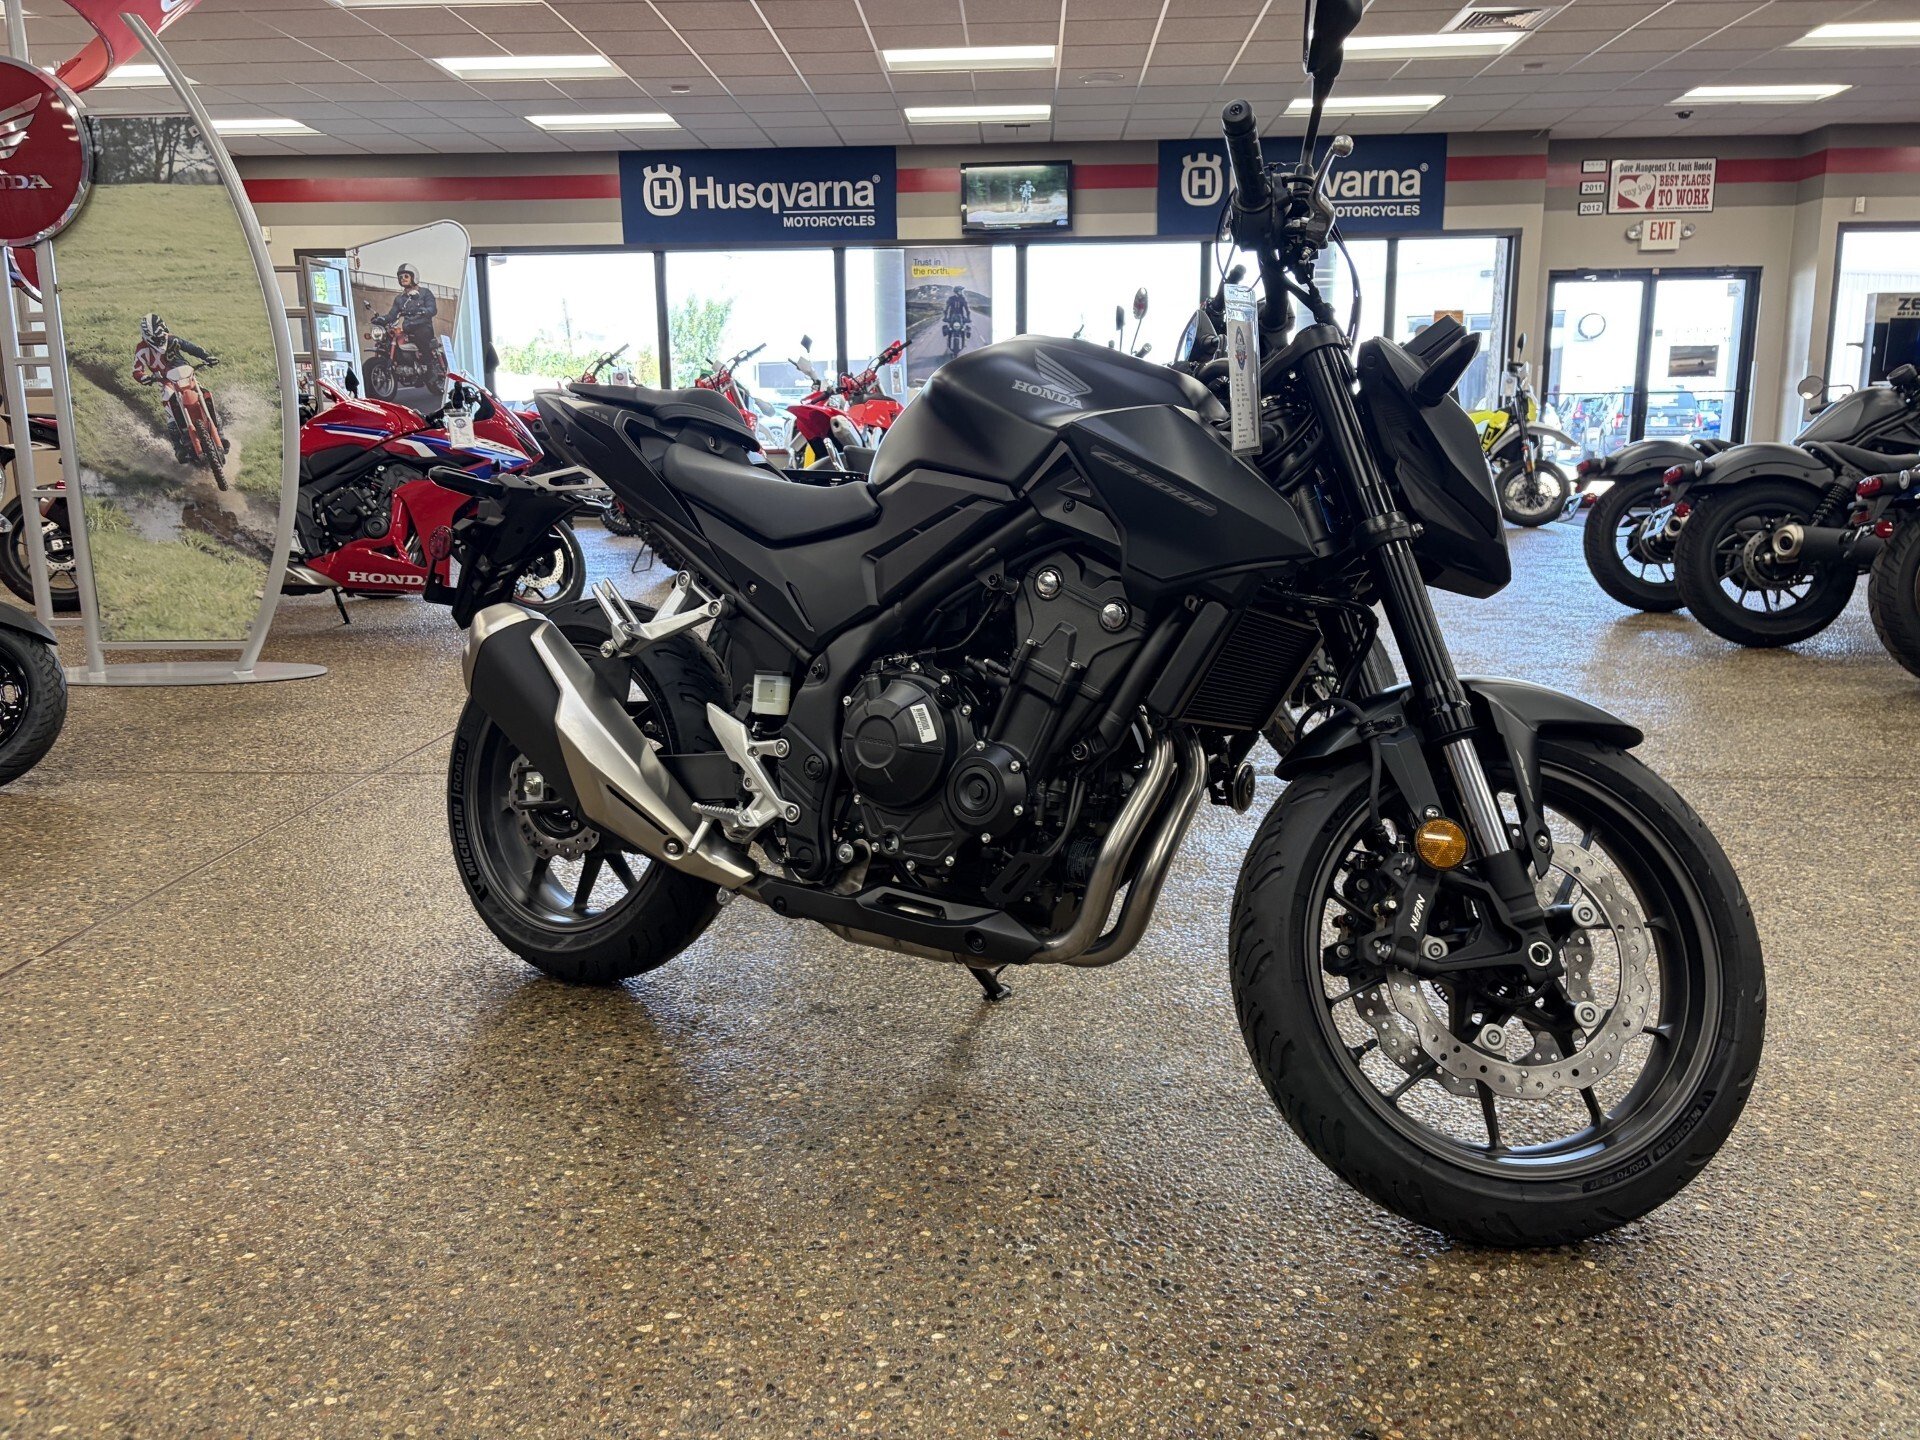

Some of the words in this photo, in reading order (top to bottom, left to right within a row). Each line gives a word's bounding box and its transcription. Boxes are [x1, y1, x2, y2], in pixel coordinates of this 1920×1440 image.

[1694, 161, 1712, 171] Honda
[1659, 174, 1680, 187] BEST
[1681, 173, 1711, 187] PLACES
[1584, 184, 1602, 192] 2011
[1623, 188, 1637, 197] my
[1638, 183, 1652, 195] job
[1659, 189, 1673, 206] TO
[1676, 188, 1710, 206] WORK
[1333, 204, 1421, 218] OTORCYCLES
[783, 215, 876, 228] MOTORCYCLES
[1649, 221, 1676, 241] EXIT
[913, 258, 932, 266] Trust
[934, 258, 941, 266] in
[913, 267, 926, 275] the
[927, 267, 950, 275] north.
[1011, 379, 1083, 410] HONDA
[347, 571, 427, 586] HOND
[453, 753, 465, 792] ROAD
[453, 804, 479, 877] MICHELIN
[1655, 1108, 1703, 1157] MICHELIN
[1616, 1159, 1649, 1180] 120/70
